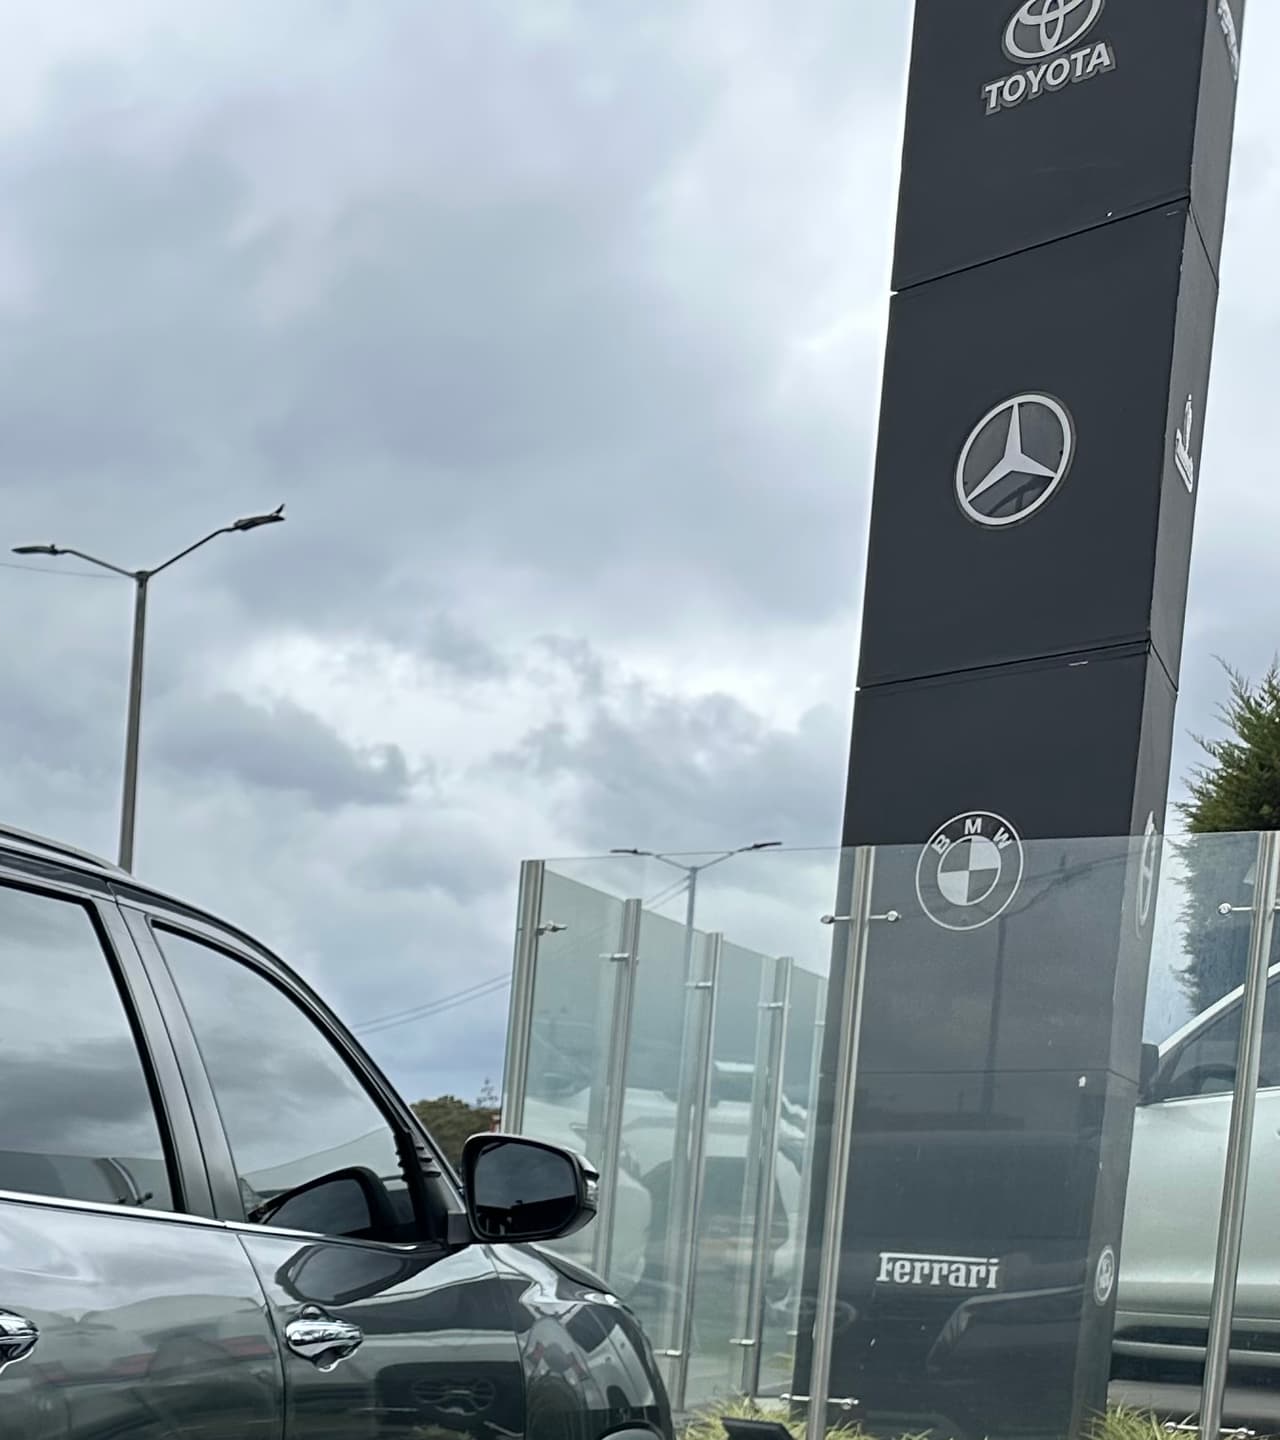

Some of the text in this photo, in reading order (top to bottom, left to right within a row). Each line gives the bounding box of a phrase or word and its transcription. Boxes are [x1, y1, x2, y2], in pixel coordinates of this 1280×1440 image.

[983, 41, 1114, 111] TOYOTA
[931, 817, 1013, 855] BMW
[876, 1252, 1000, 1289] Ferrari
